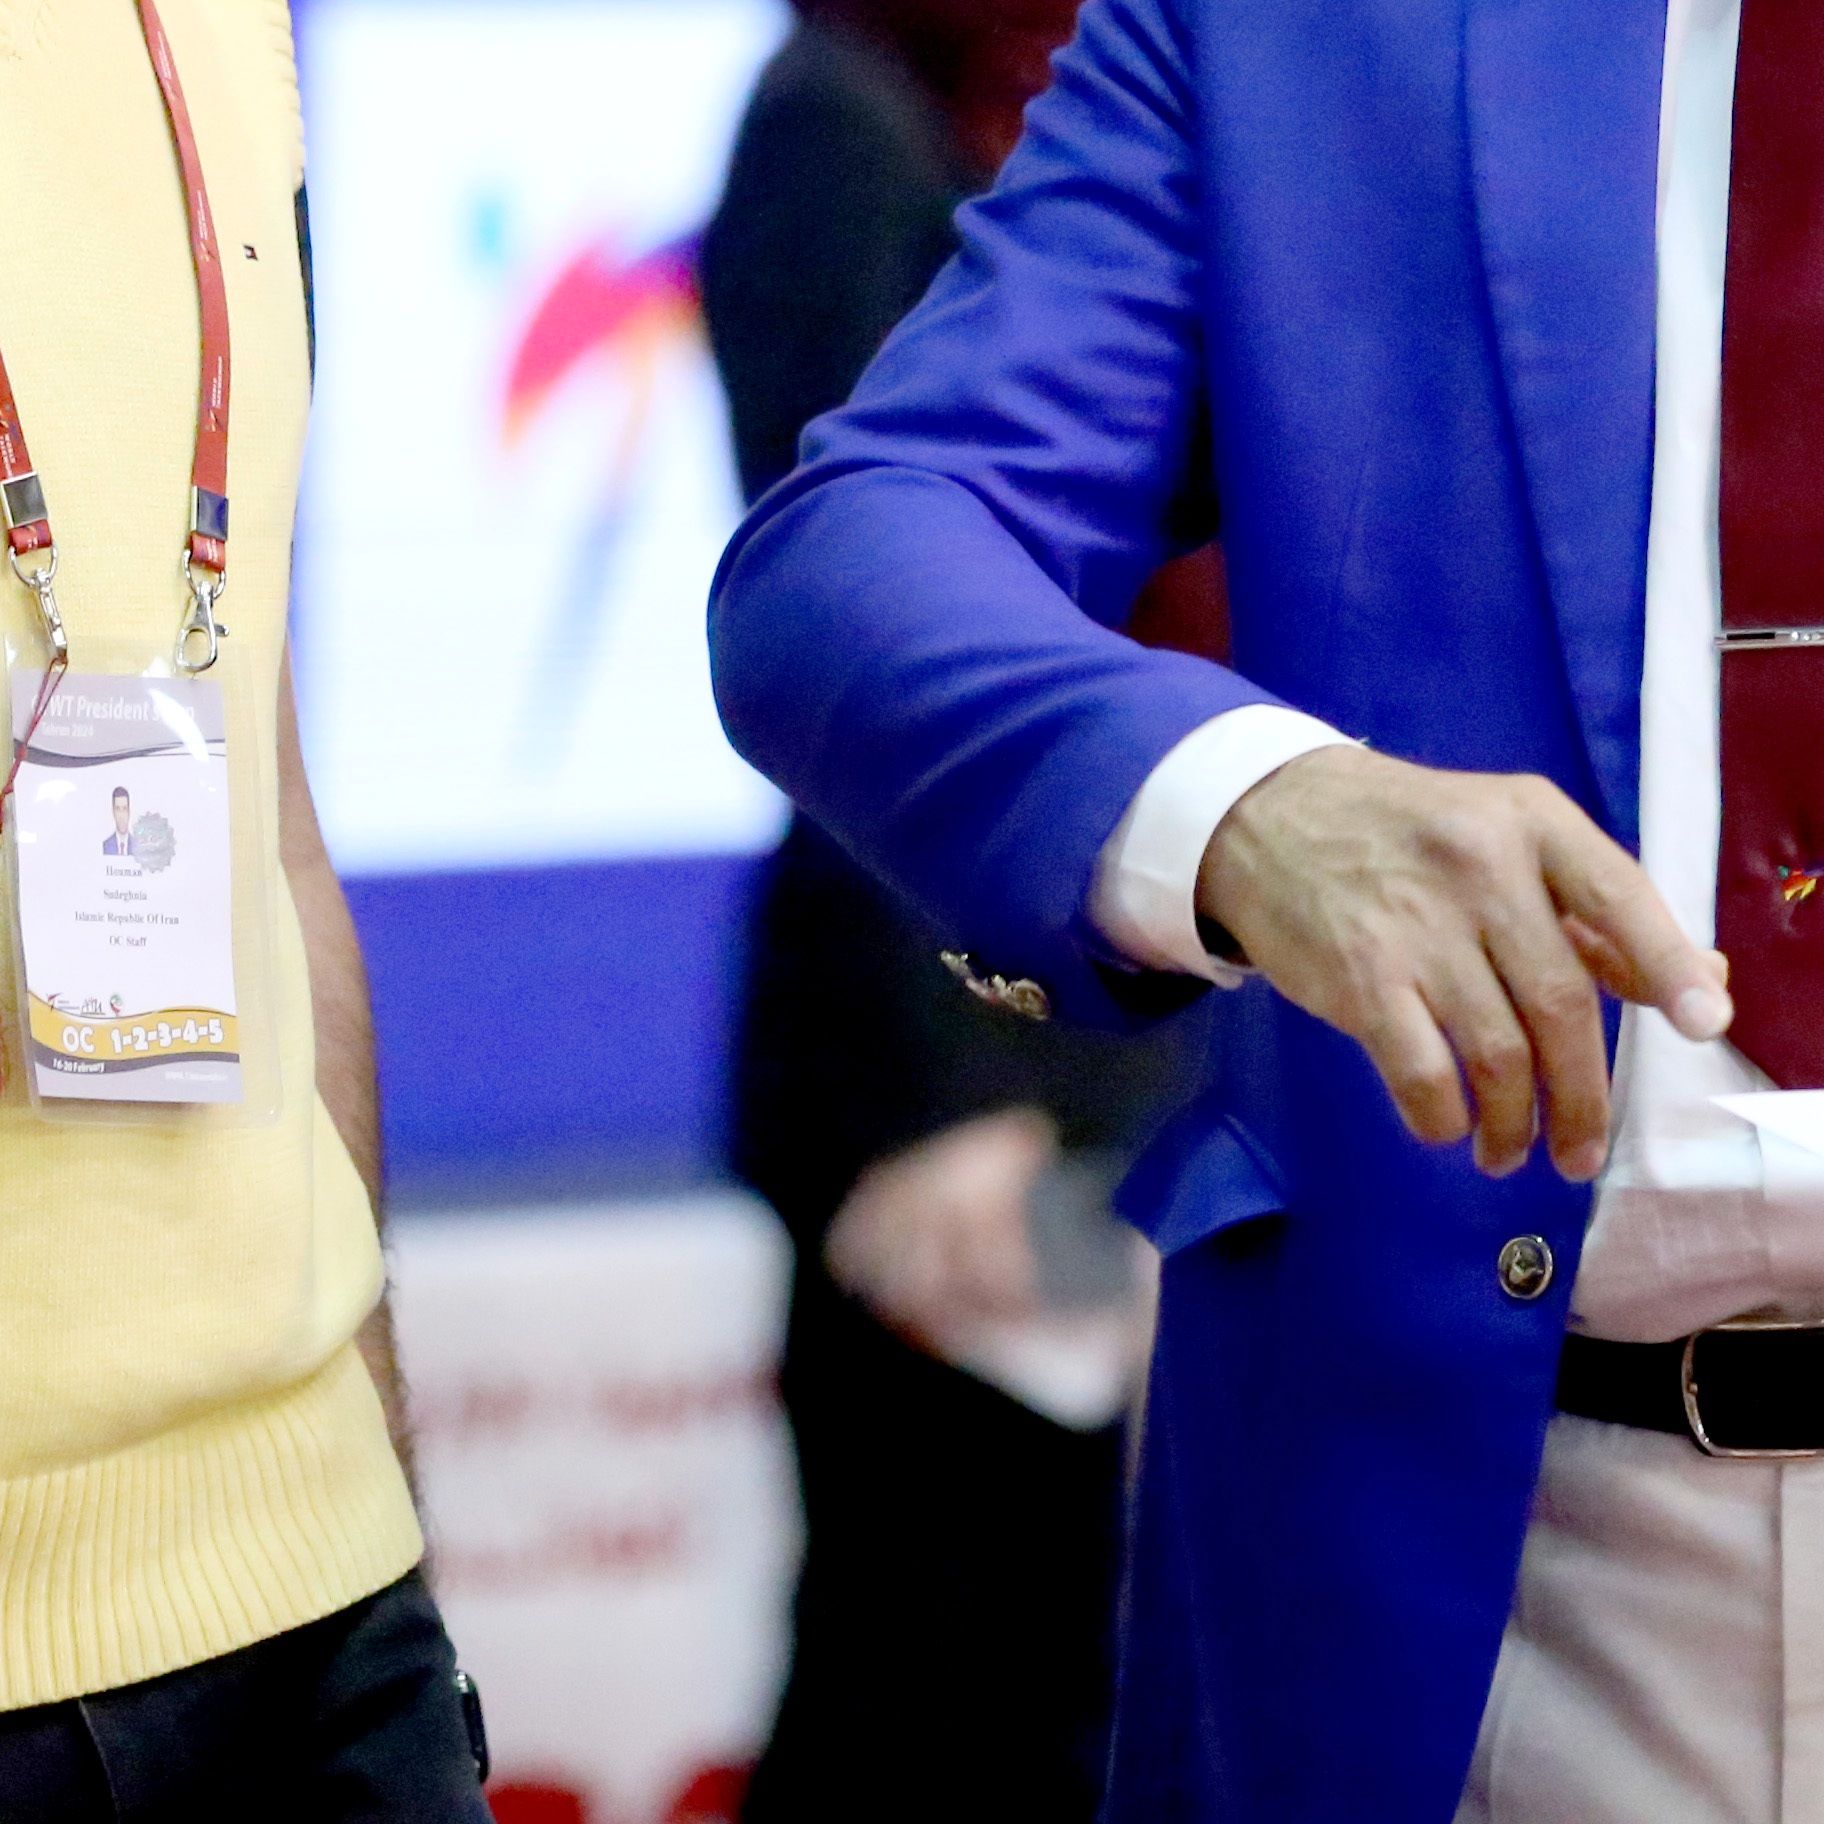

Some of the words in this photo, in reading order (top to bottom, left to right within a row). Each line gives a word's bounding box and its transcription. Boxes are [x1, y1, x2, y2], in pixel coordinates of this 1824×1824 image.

[75, 911, 104, 923] Islamic
[107, 912, 144, 925] Republic
[147, 913, 158, 924] Of
[161, 914, 180, 925] Iran
[109, 935, 123, 946] OC
[126, 936, 147, 947] Staff
[62, 1026, 95, 1053] OC
[110, 1018, 224, 1054] 1-2-3-4-5
